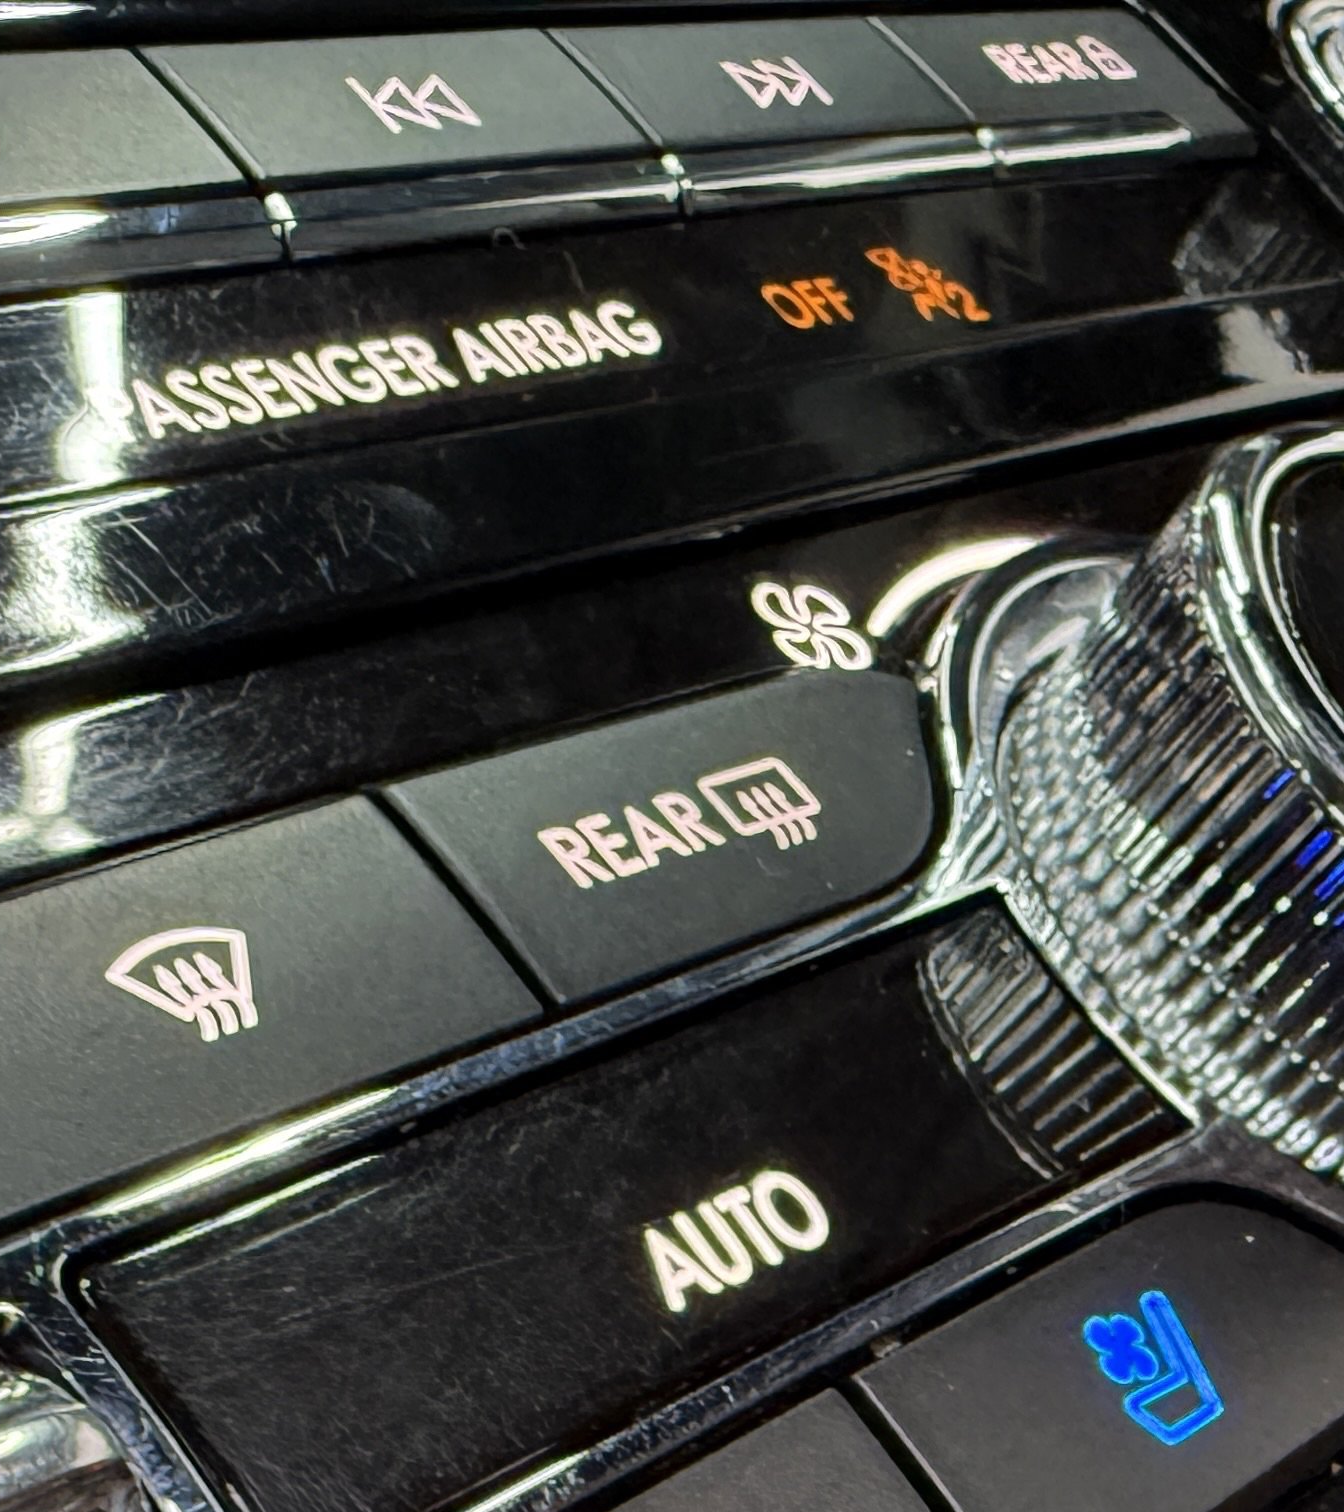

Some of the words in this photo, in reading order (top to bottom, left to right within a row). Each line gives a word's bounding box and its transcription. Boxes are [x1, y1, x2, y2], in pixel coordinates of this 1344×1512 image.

[981, 41, 1100, 85] REAR
[452, 299, 664, 384] AIRBAG
[760, 276, 855, 330] OFF
[536, 791, 727, 889] REAR
[643, 1169, 830, 1313] AUTO
